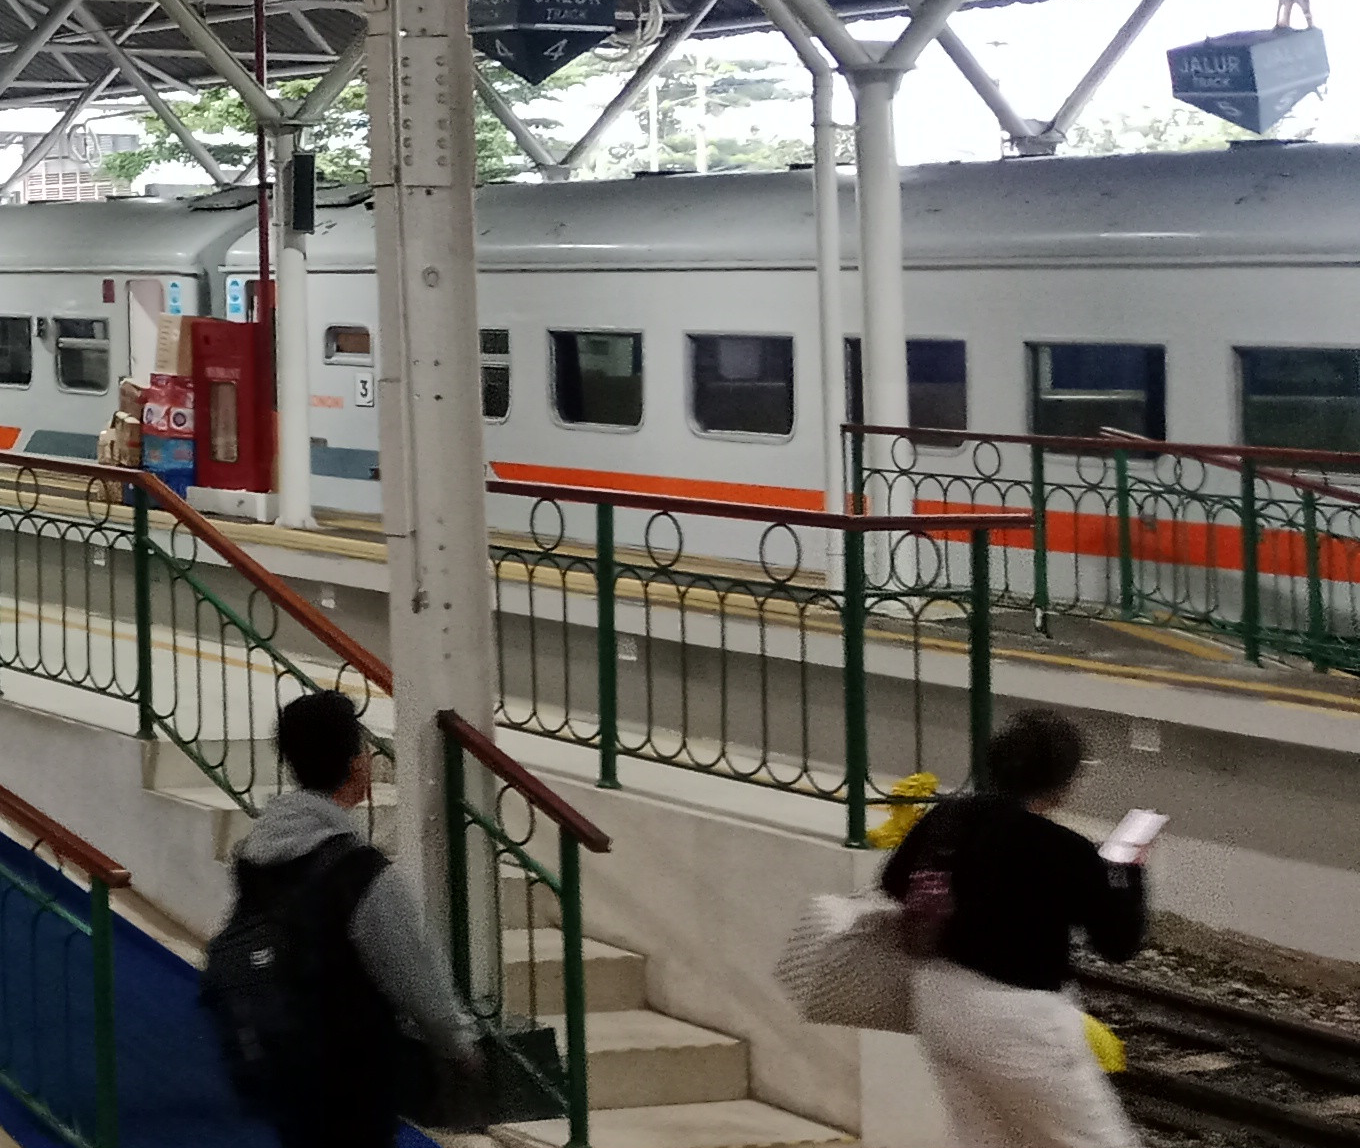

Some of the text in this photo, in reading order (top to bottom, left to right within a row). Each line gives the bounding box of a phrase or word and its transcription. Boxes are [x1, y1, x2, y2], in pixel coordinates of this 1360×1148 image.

[542, 38, 569, 61] 4
[1180, 55, 1241, 73] JALUR
[359, 379, 369, 399] 3
